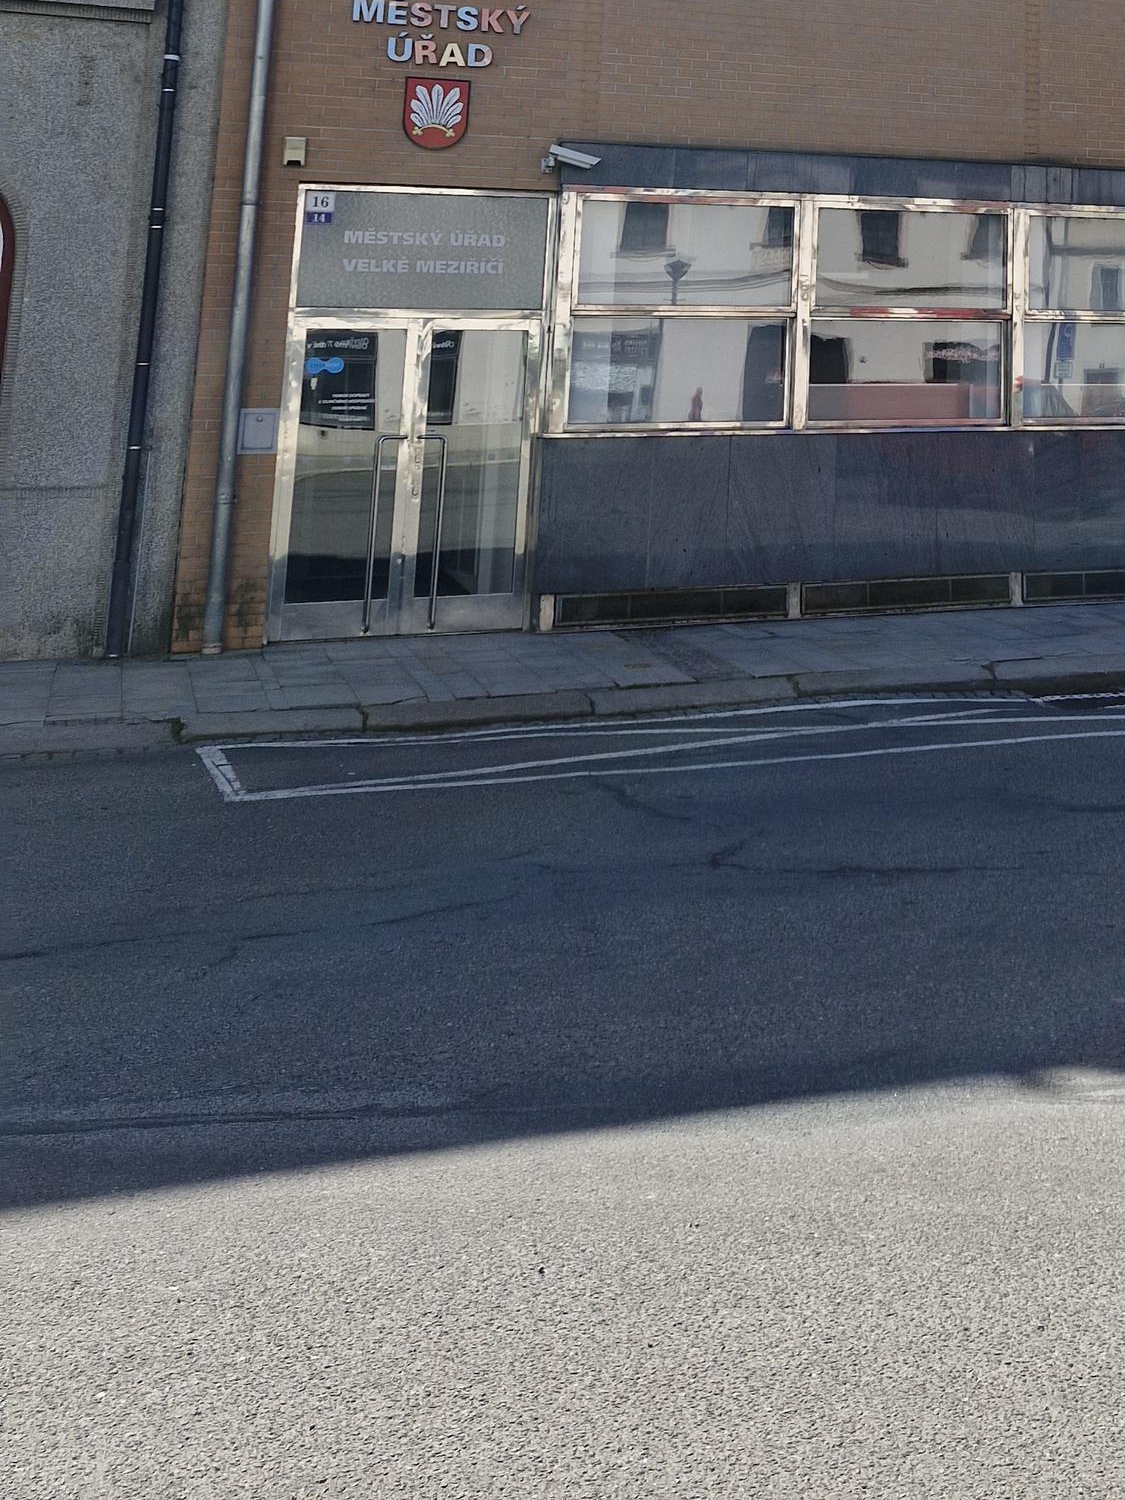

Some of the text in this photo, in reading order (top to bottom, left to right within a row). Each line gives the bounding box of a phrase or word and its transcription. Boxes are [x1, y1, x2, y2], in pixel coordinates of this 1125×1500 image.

[386, 32, 493, 68] ÚŘAD
[312, 196, 329, 208] 16
[313, 213, 326, 223] 14
[343, 227, 507, 248] MĚSTSKÝ ÚŘAD
[343, 256, 505, 275] VELKÉ MEZIŘÍČÍ
